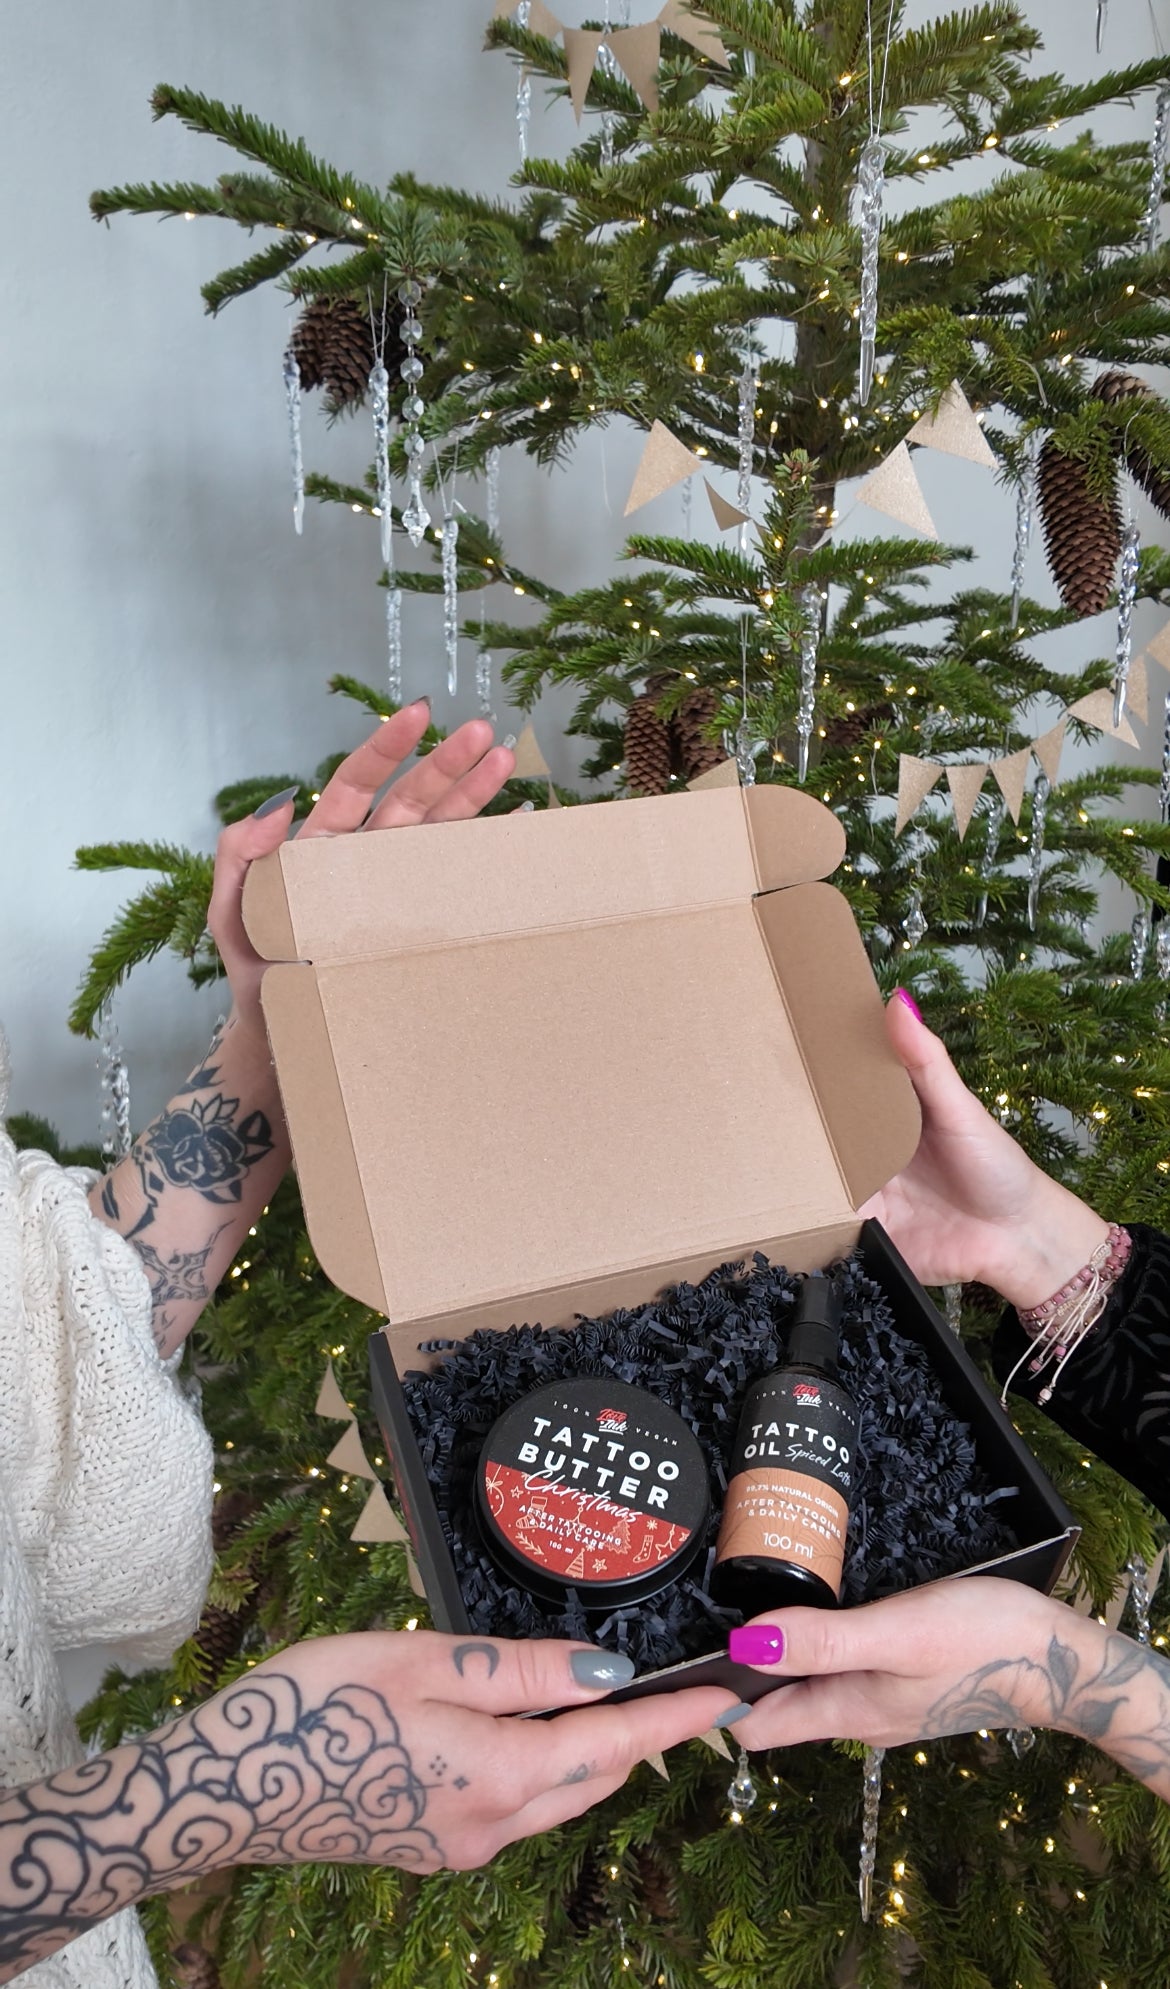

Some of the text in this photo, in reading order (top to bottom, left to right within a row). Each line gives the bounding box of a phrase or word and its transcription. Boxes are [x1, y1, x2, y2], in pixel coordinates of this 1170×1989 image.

[533, 1416, 680, 1481] TATTOO
[636, 1427, 678, 1446] VEGAN
[751, 1421, 850, 1464] TATTOO
[744, 1441, 781, 1460] OIL
[784, 1443, 832, 1468] Spiced
[518, 1442, 670, 1509] BUTTER
[524, 1469, 644, 1523] Christmas
[771, 1485, 813, 1501] NATURAL
[814, 1497, 839, 1518] ORIGIN
[519, 1505, 622, 1546] AFTER TATTOOING
[736, 1498, 841, 1539] AFTER TATTOOING
[748, 1508, 831, 1540] & DAILY CARE
[539, 1522, 572, 1538] DAILY
[574, 1534, 605, 1550] CARE
[549, 1540, 574, 1555] 100 ml
[763, 1532, 814, 1559] 100 ml
